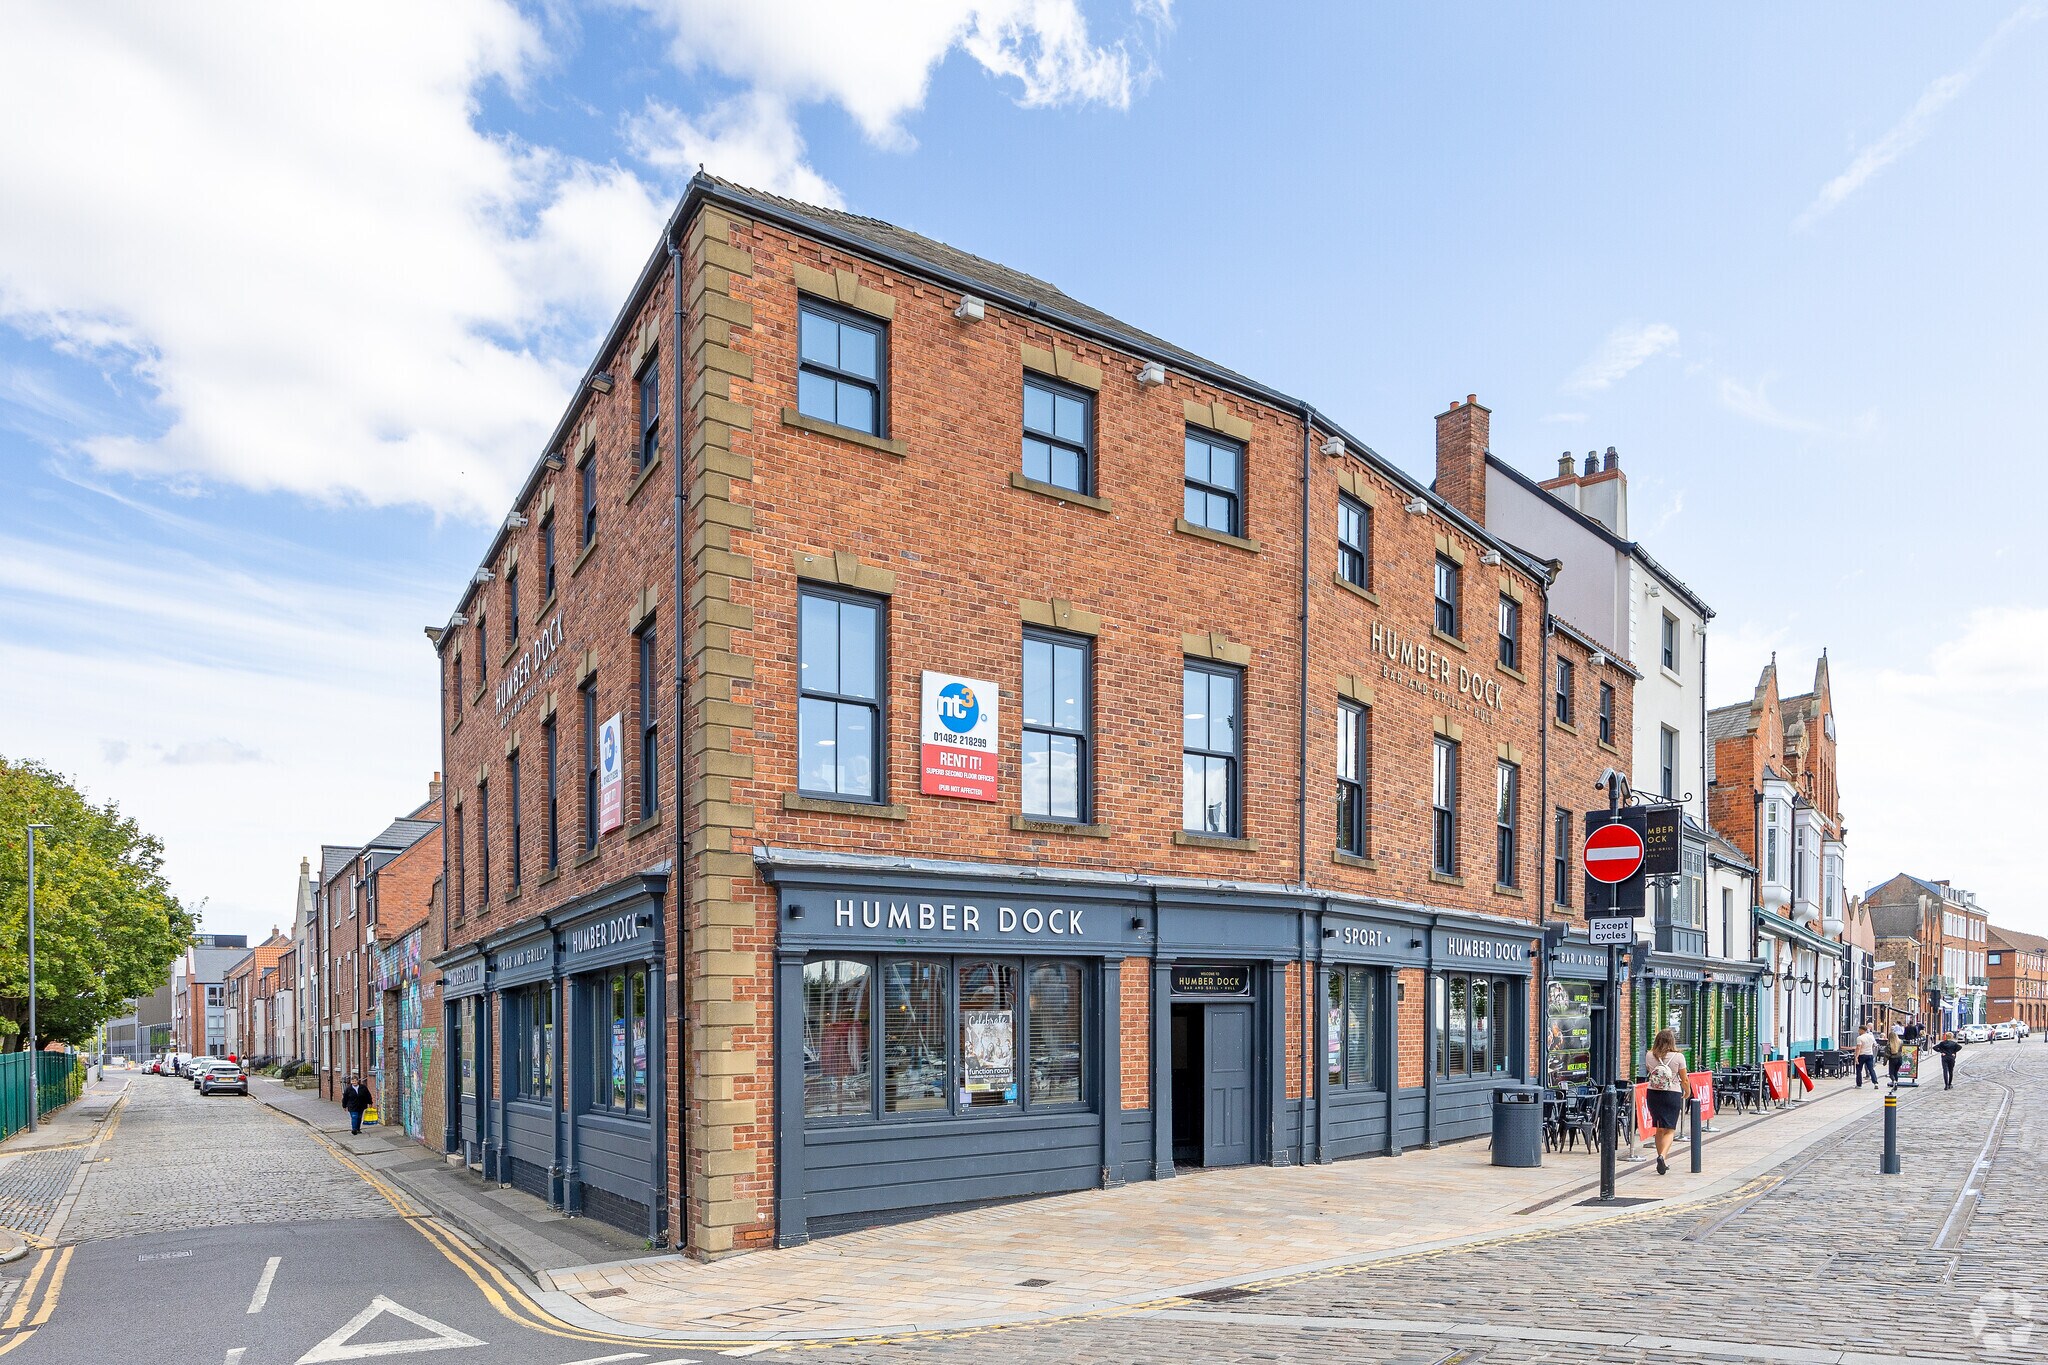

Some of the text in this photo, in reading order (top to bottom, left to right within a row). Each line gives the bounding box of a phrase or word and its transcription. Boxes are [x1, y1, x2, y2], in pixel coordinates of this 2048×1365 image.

[496, 609, 564, 715] HUMBER DOCK
[1372, 621, 1503, 710] HUMBER DOCK
[1382, 665, 1494, 725] BAR AND GRILL HULL
[501, 712, 510, 728] BAR
[511, 700, 521, 718] AND
[522, 683, 538, 705] GRILL
[934, 732, 987, 748] 01482 218299
[940, 752, 982, 770] RENT IT!
[926, 768, 994, 782] SUPERB SECOND FLOOR OFFICES
[1648, 826, 1674, 834] MBER
[836, 900, 1084, 934] HUMBER DOCK
[572, 912, 638, 954] HUMBER DOCK
[1595, 922, 1628, 932] Except
[1344, 927, 1382, 947] SPORT
[1595, 932, 1626, 942] cycles
[502, 946, 544, 970] BAR AND GRILL
[1448, 937, 1522, 962] HUMBER DOCK
[1561, 952, 1575, 964] BAR
[1578, 954, 1592, 965] AND
[1217, 978, 1239, 986] DOCK
[1672, 968, 1684, 978] DOCK
[969, 1013, 1008, 1027] Celebrate
